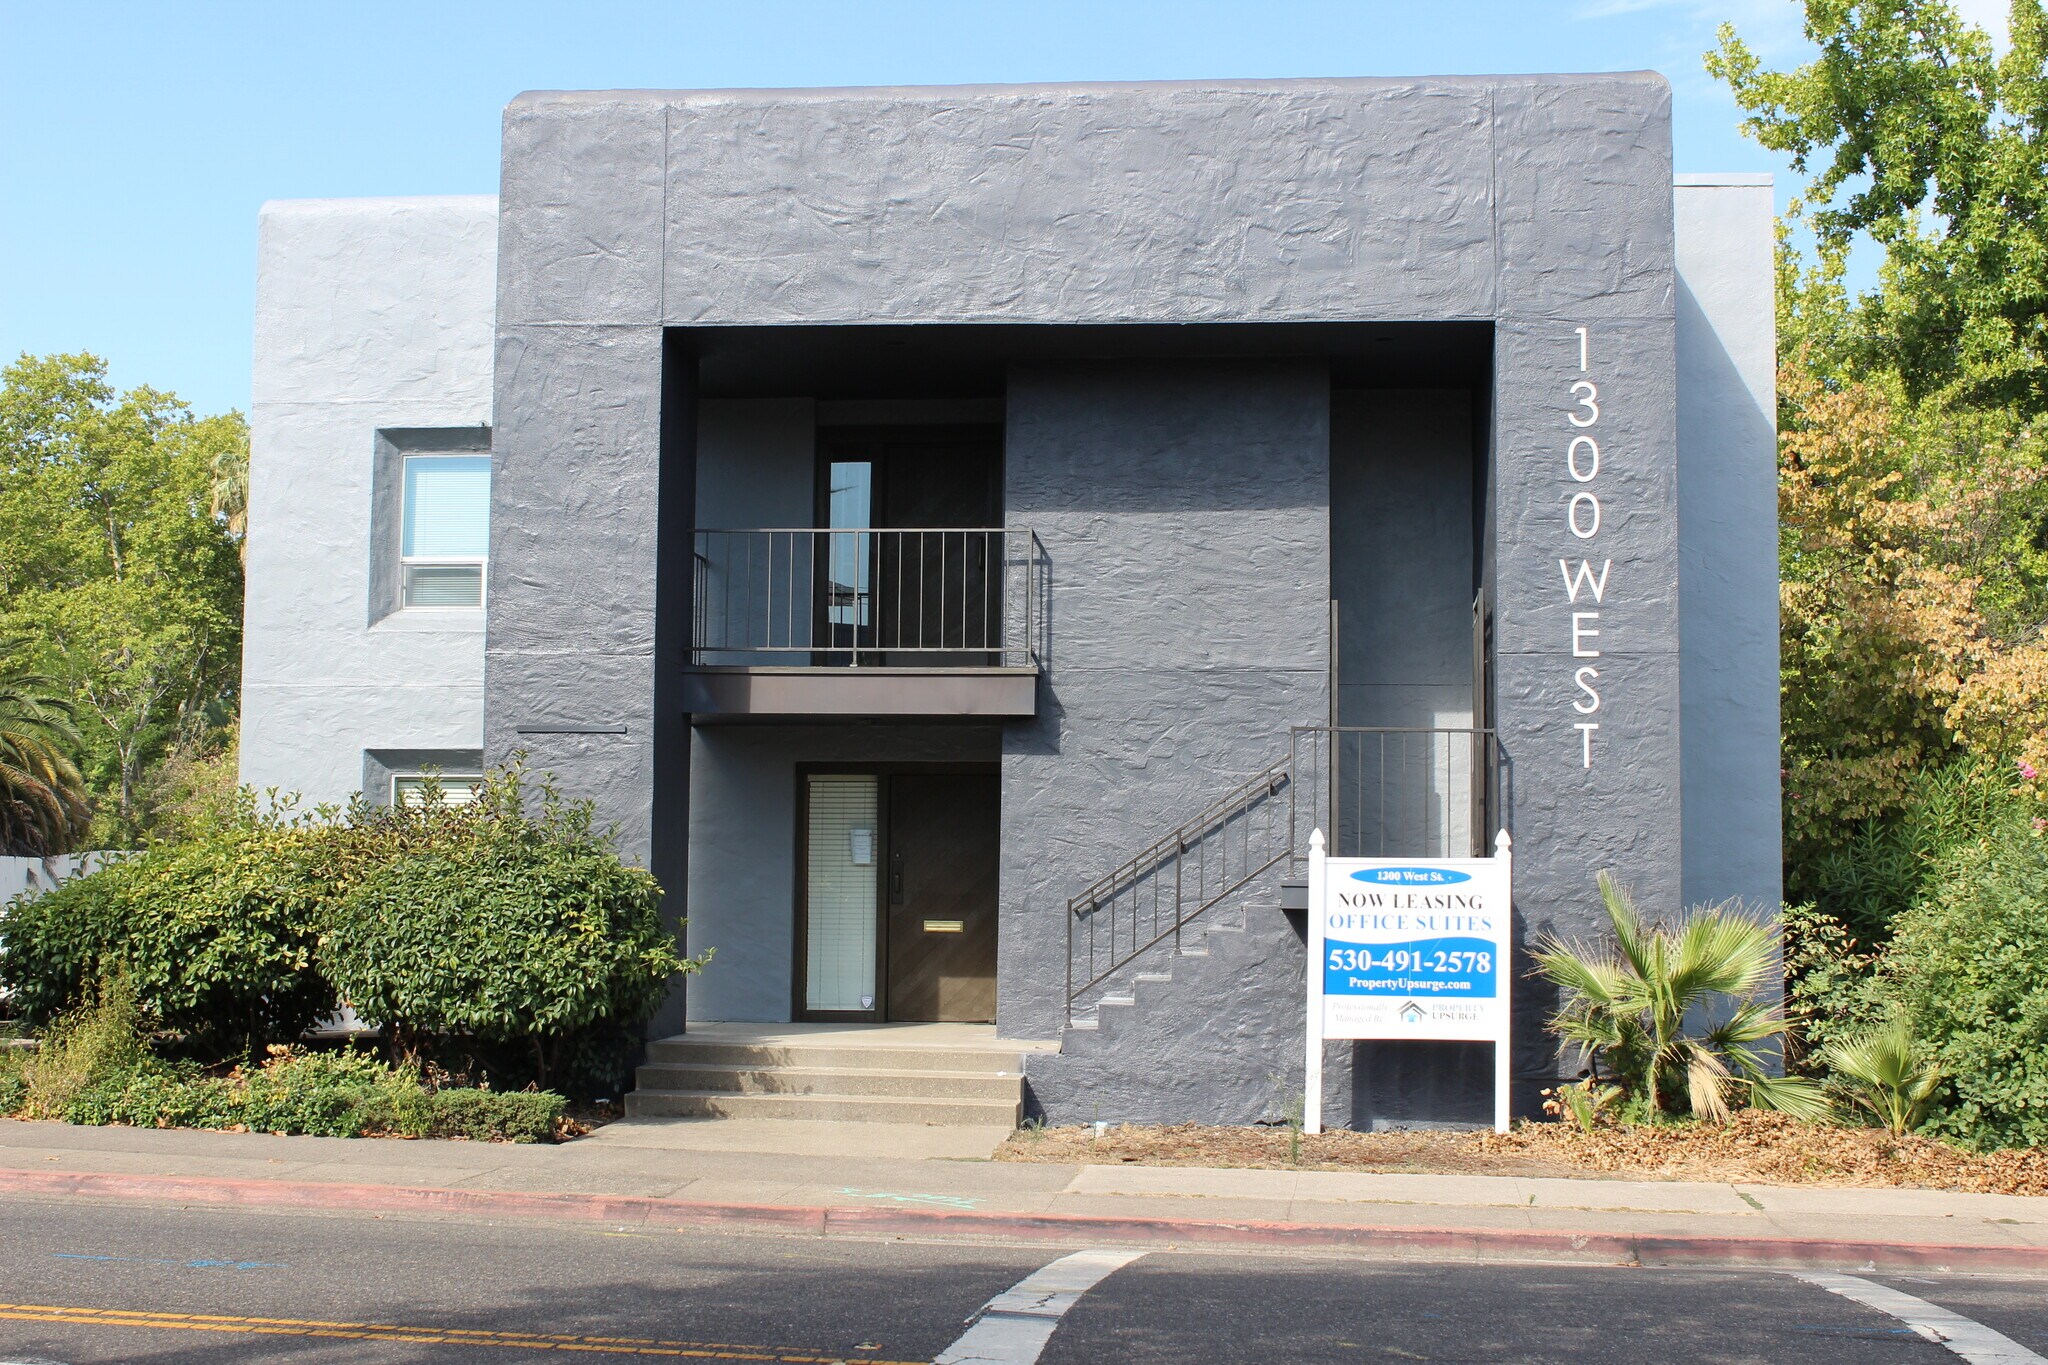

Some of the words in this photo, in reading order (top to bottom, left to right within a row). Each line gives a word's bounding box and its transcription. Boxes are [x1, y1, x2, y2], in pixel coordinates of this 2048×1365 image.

[1567, 327, 1600, 538] 1300
[1559, 558, 1611, 769] WEST
[1377, 871, 1401, 881] 1300
[1403, 871, 1428, 881] West
[1430, 871, 1444, 882] St.
[1338, 893, 1386, 908] NOW
[1393, 893, 1483, 909] LEASING
[1329, 914, 1408, 929] OFFICE
[1415, 916, 1492, 931] SUITES
[1329, 949, 1491, 973] 530-491-2578
[1348, 977, 1471, 991] PropertyUpsurge.com
[1432, 1003, 1484, 1012] PROPERTY
[1432, 1012, 1479, 1020] UPSURGE
